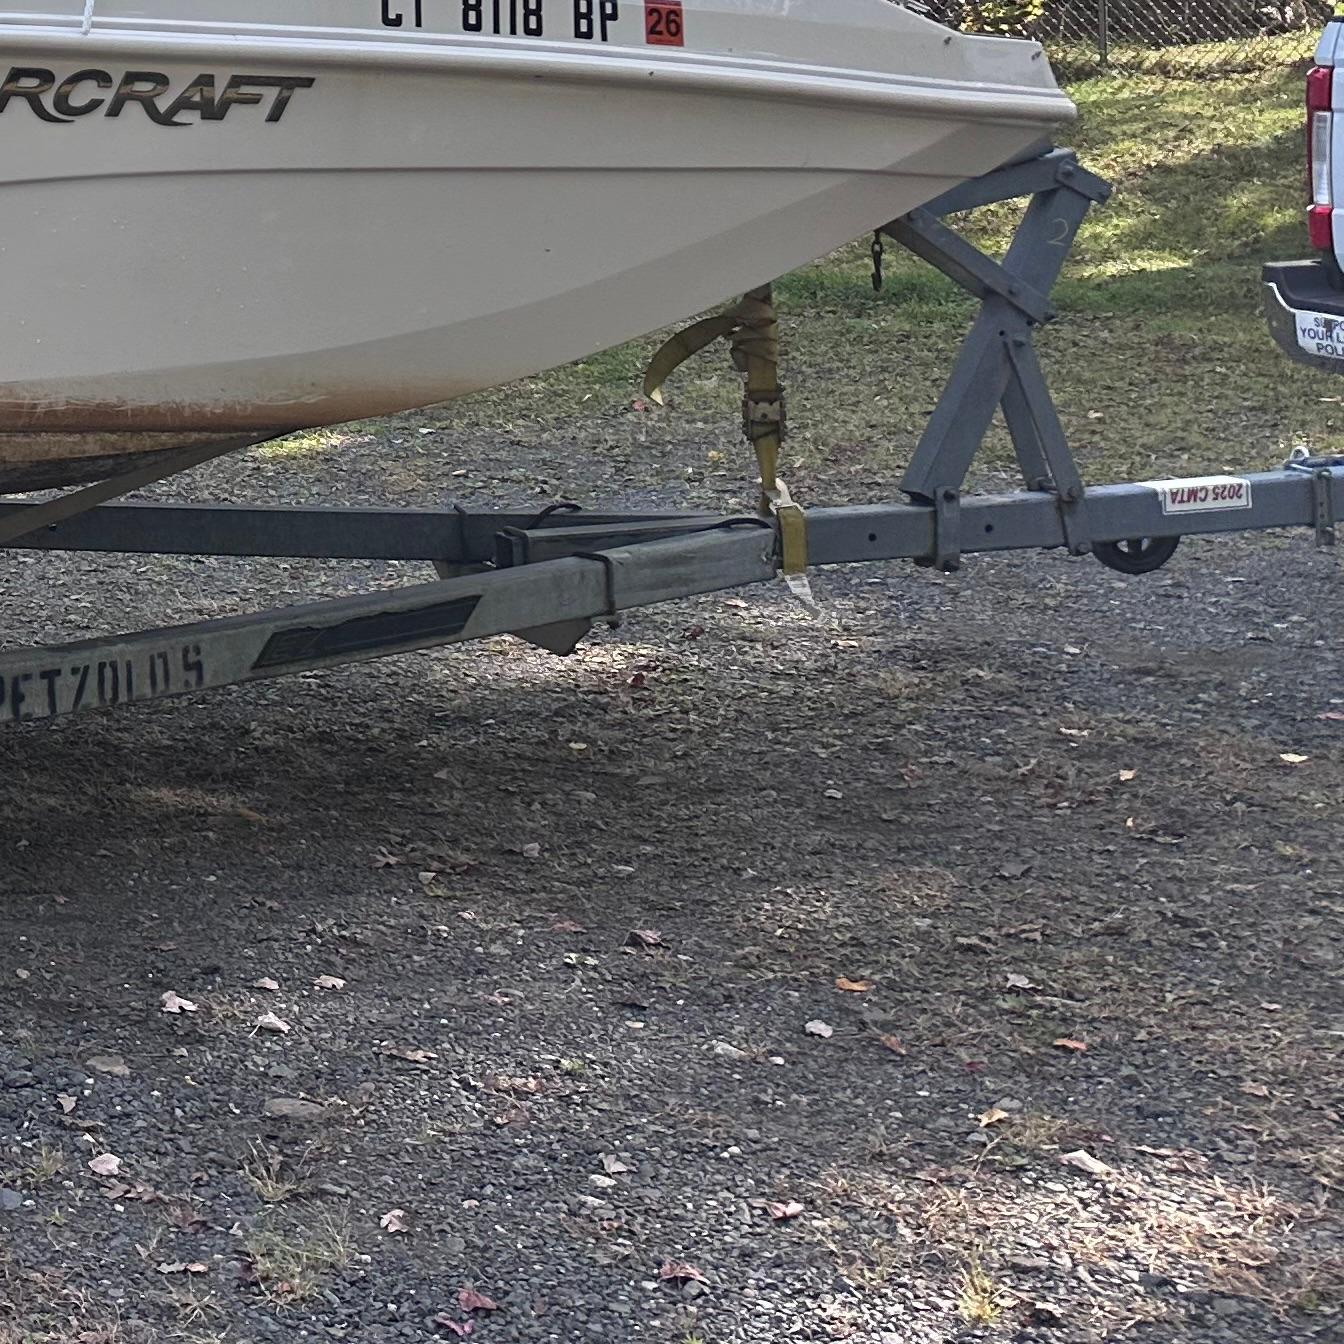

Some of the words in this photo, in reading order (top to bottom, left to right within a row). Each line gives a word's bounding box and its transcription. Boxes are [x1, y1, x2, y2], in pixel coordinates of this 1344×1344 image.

[647, 8, 681, 38] 26
[1300, 325, 1333, 343] YOUR
[1212, 483, 1243, 502] 2025
